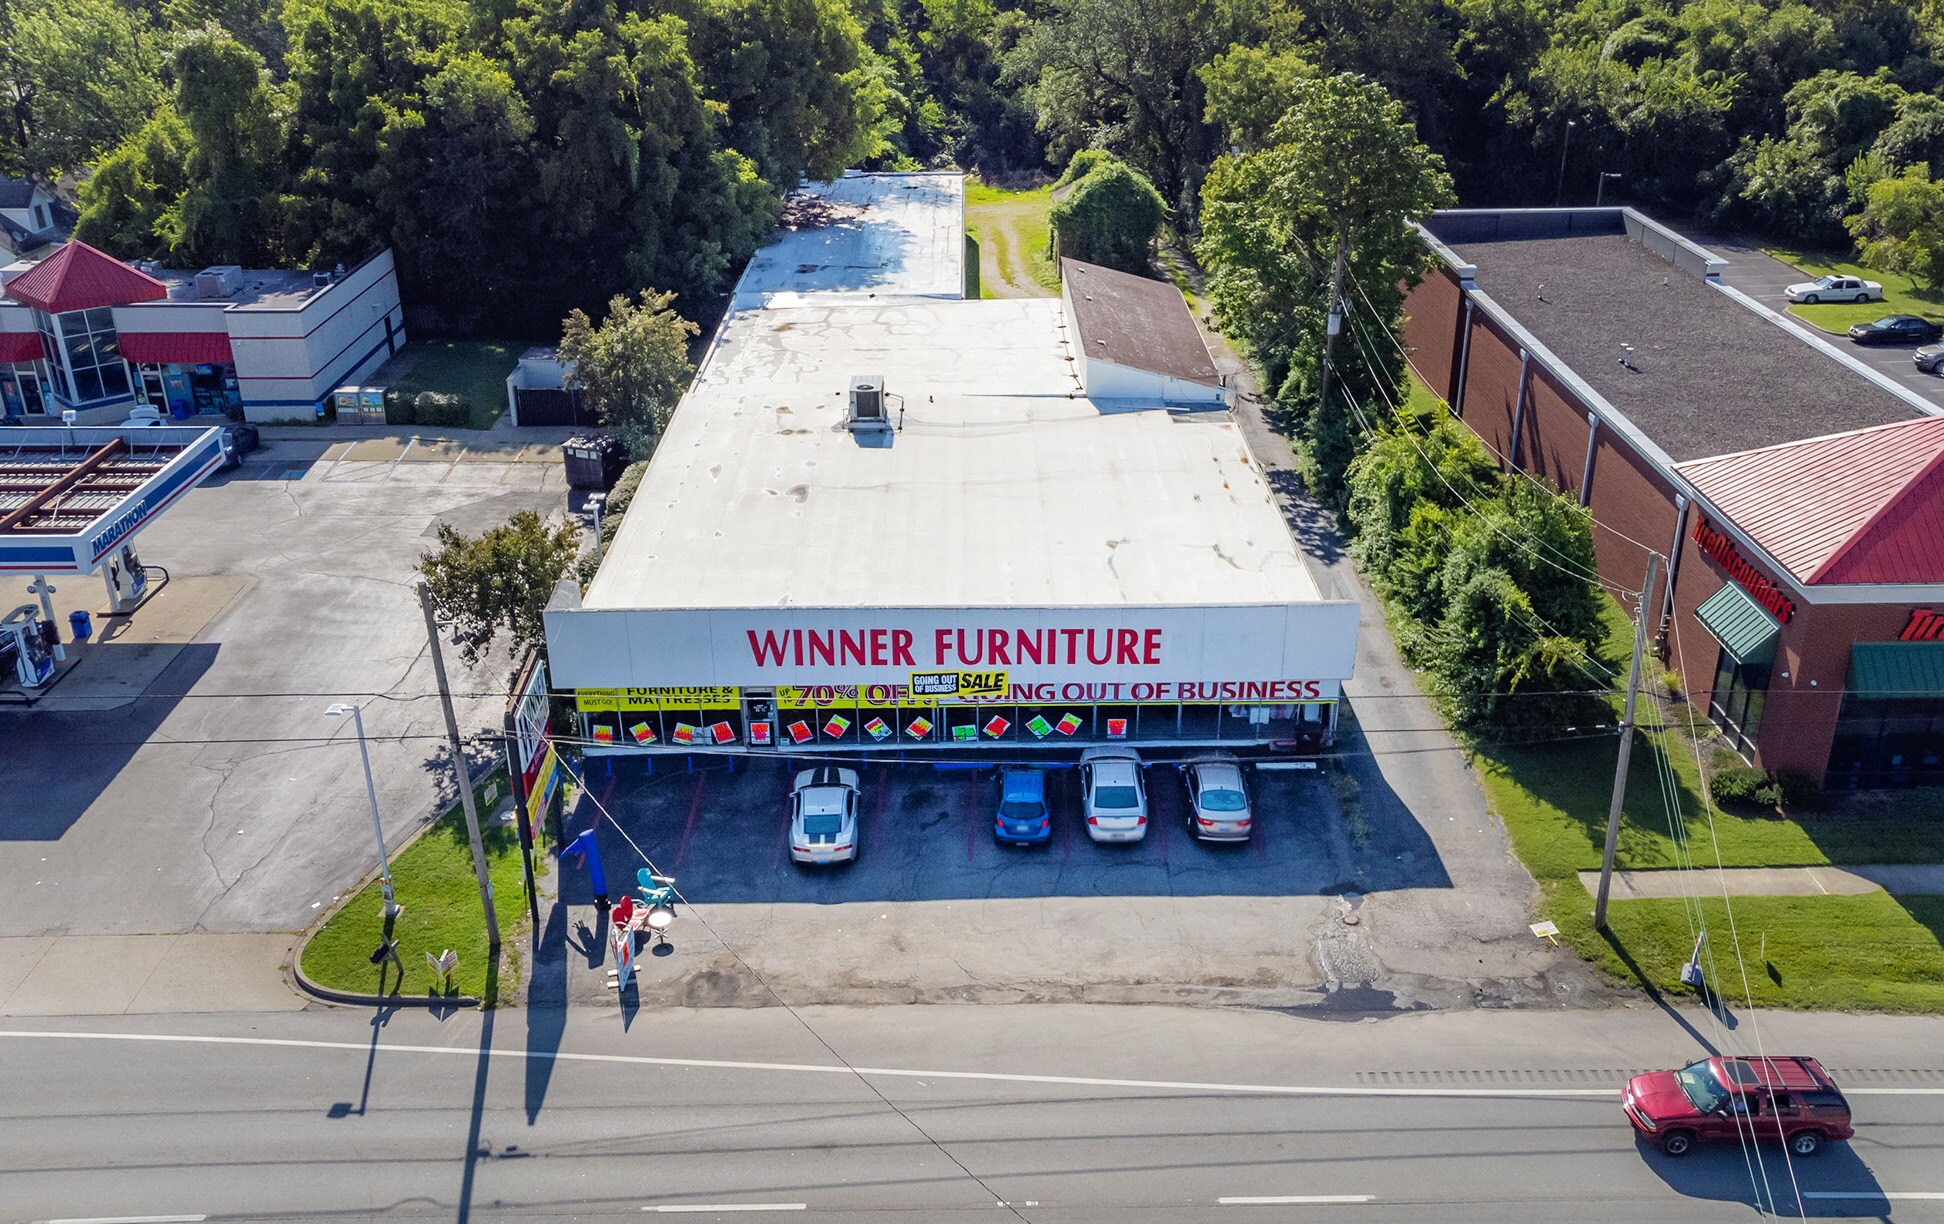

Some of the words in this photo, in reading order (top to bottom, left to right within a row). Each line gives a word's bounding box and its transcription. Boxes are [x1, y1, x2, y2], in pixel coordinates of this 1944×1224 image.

[91, 500, 147, 556] MARATHON
[1899, 609, 1944, 641] Tir
[746, 629, 916, 667] WINNER
[935, 629, 1162, 666] FURNITURE
[913, 674, 940, 685] GOING
[941, 674, 958, 685] OUT
[960, 673, 1006, 689] SALE
[627, 687, 718, 696] FURNITURE
[722, 686, 733, 694] &
[779, 688, 791, 697] UP
[914, 685, 925, 693] OF
[925, 684, 957, 693] BUSINESS
[957, 683, 1057, 702] ING
[1063, 682, 1127, 702] OUT
[1130, 681, 1172, 701] OF
[1178, 680, 1321, 700] BUSINESS
[583, 698, 601, 706] MUST
[601, 698, 613, 706] GO!
[783, 695, 793, 704] TO
[792, 684, 859, 707] 70%
